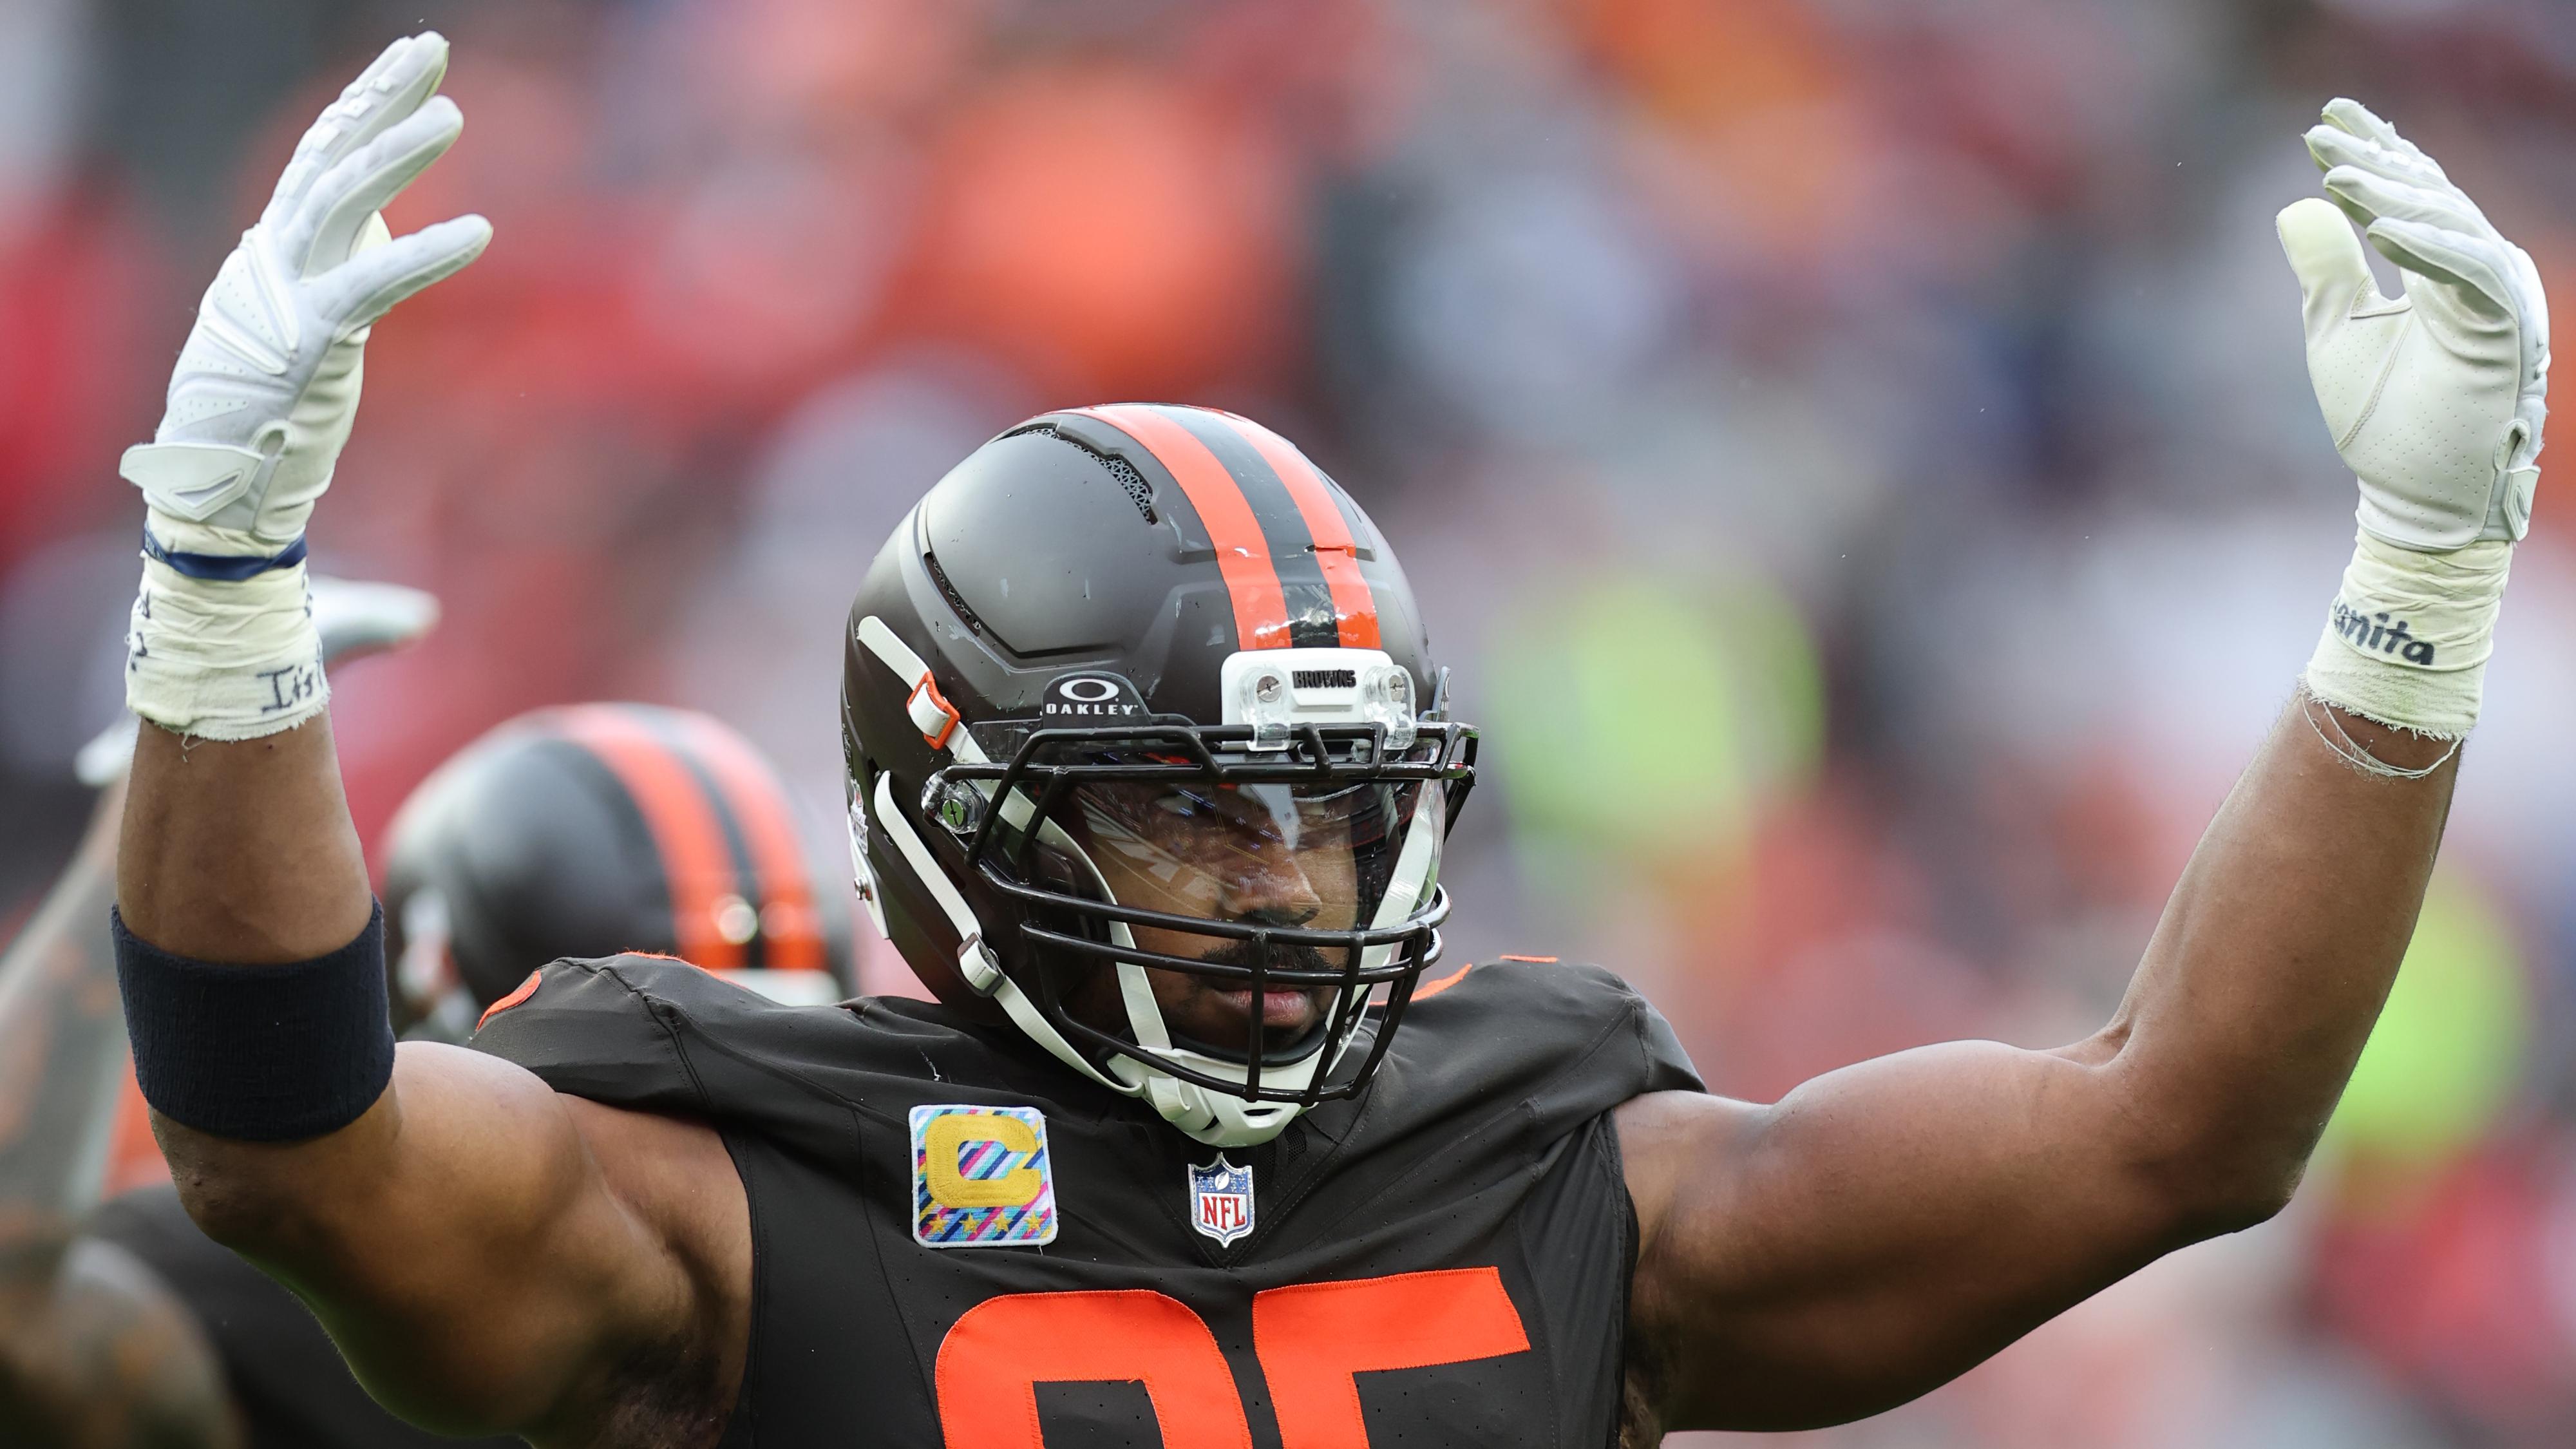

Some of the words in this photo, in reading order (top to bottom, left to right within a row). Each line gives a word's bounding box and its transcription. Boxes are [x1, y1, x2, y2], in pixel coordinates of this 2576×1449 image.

[1292, 669, 1356, 688] BROWNS
[1046, 703, 1136, 715] OAKLEY
[925, 1115, 1041, 1209] C
[1202, 1196, 1245, 1230] NFL
